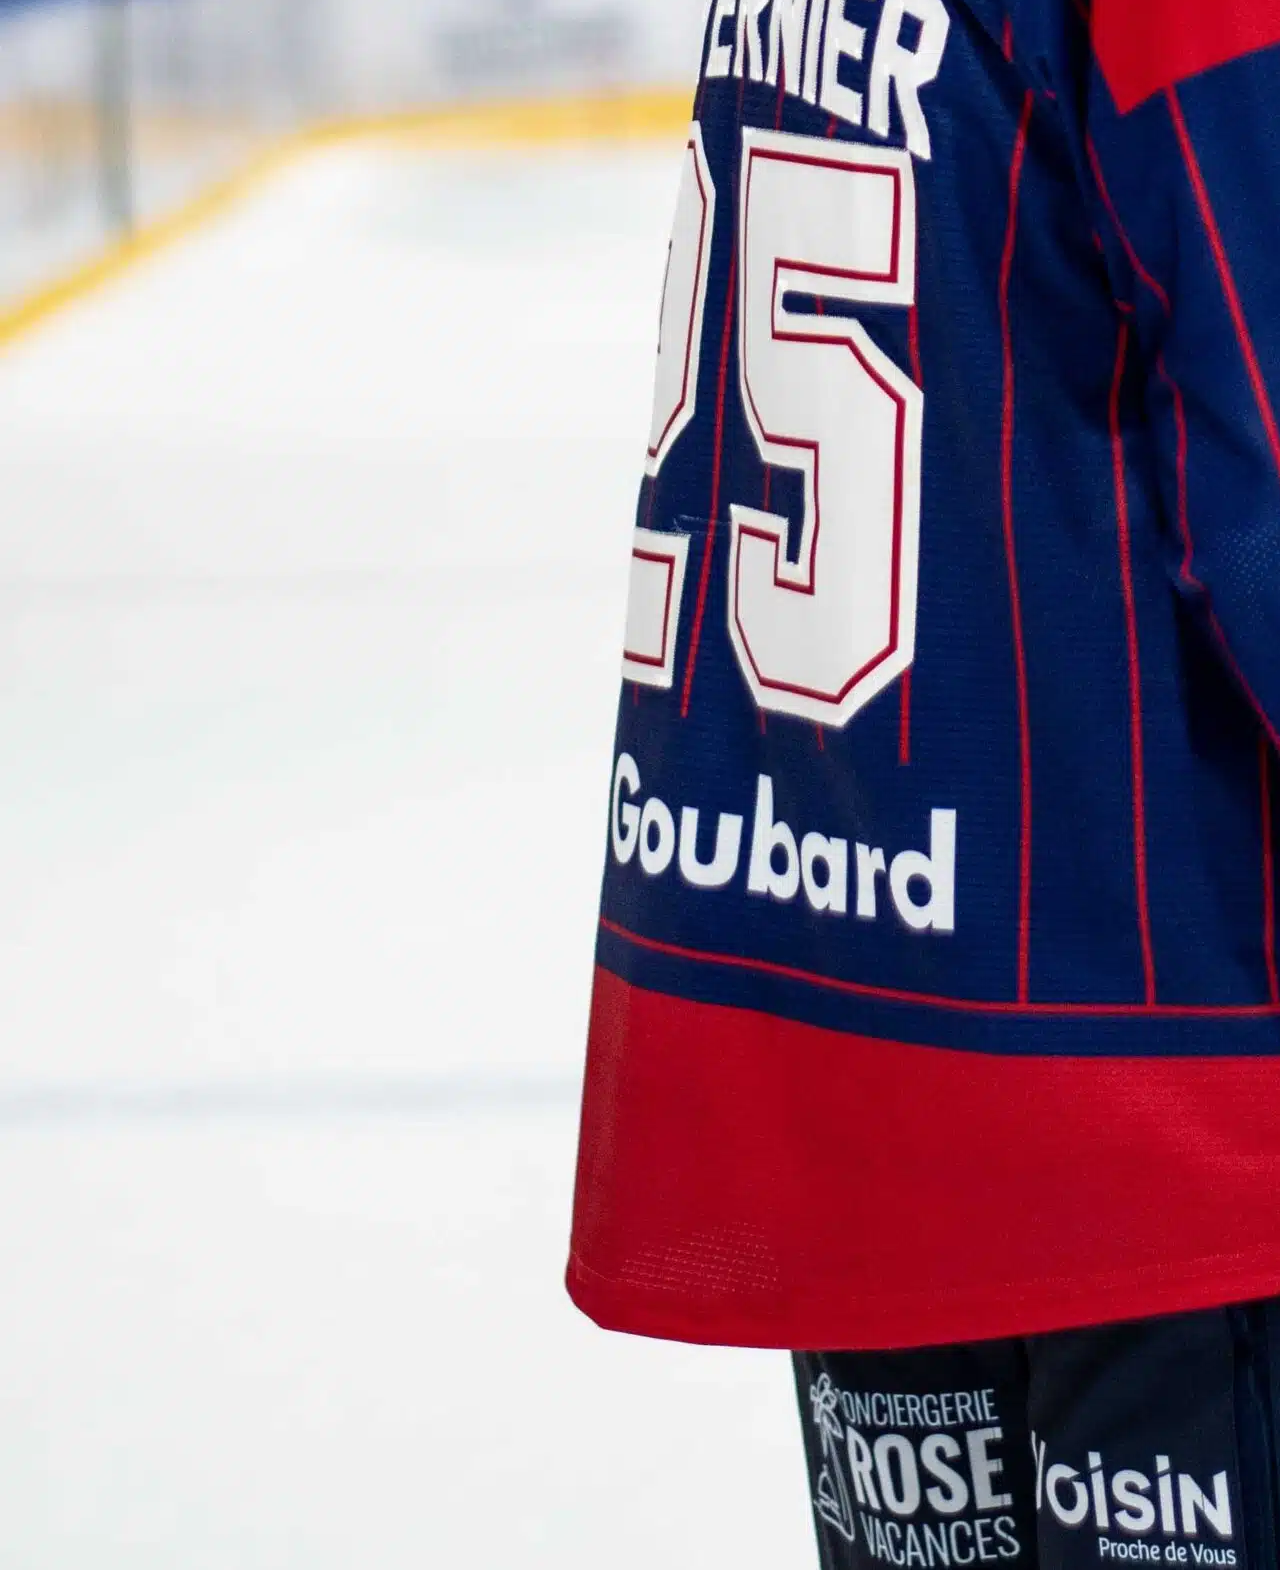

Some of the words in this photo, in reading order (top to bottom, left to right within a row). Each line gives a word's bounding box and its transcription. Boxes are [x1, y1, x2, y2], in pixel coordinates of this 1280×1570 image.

[611, 751, 958, 933] Goubard
[846, 1425, 1014, 1516] ROSE
[859, 1509, 1022, 1568] VACANCES
[1098, 1536, 1160, 1561] Proche
[1165, 1540, 1188, 1563] de
[1190, 1542, 1237, 1565] Vous
